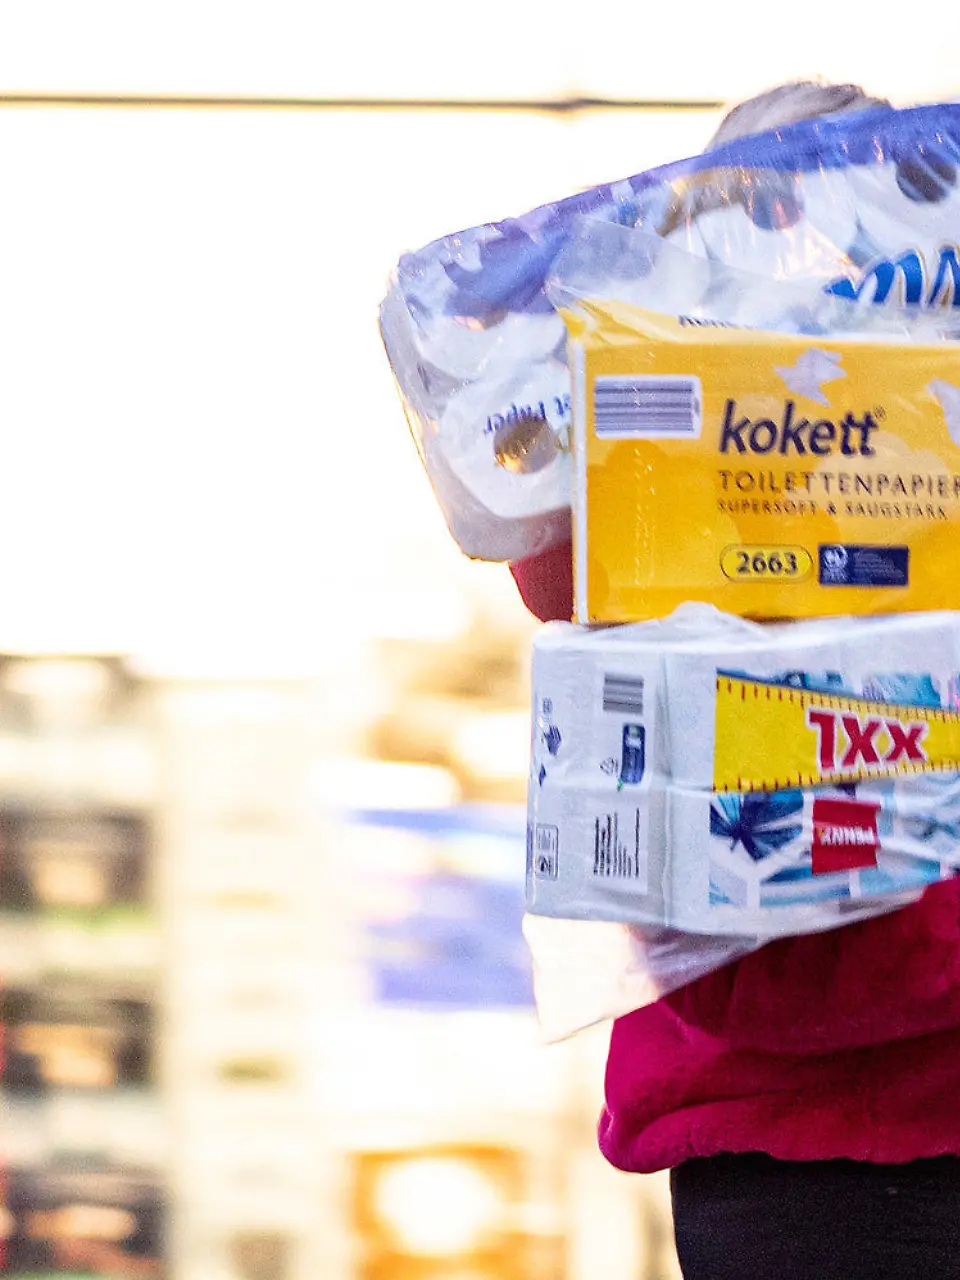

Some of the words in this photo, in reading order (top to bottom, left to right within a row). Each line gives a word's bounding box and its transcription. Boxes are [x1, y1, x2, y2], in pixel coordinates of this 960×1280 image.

[719, 399, 878, 457] kokett
[718, 499, 818, 516] SUPERSOFT
[735, 550, 799, 575] 2663
[808, 710, 929, 771] XXL
